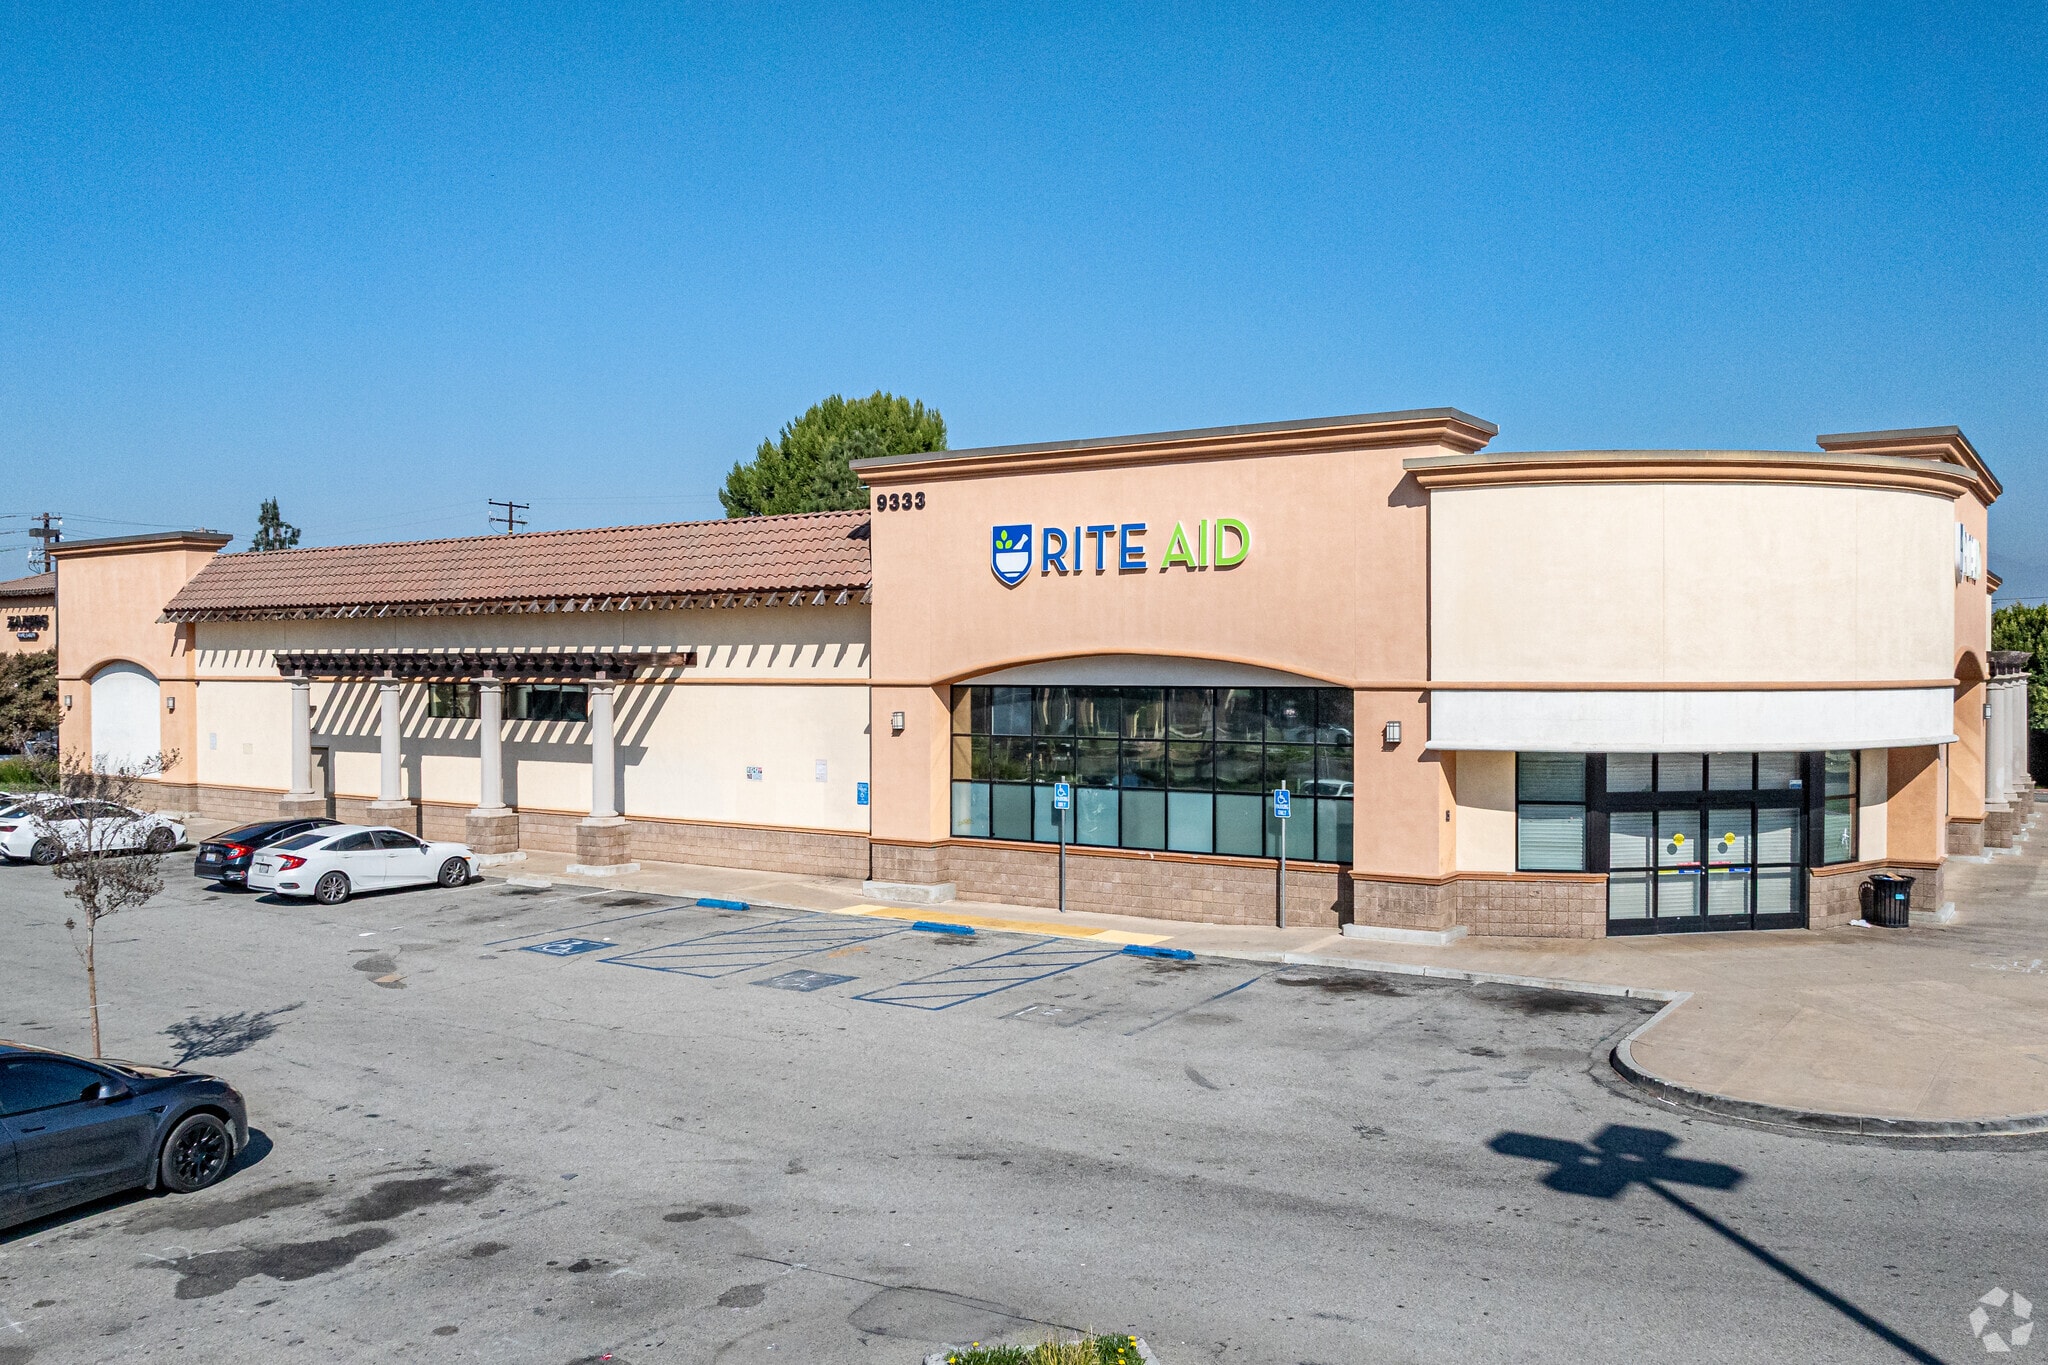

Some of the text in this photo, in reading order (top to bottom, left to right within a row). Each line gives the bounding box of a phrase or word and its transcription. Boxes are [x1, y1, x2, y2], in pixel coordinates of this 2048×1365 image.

[877, 491, 926, 513] 9333
[1042, 518, 1251, 572] RITE AID
